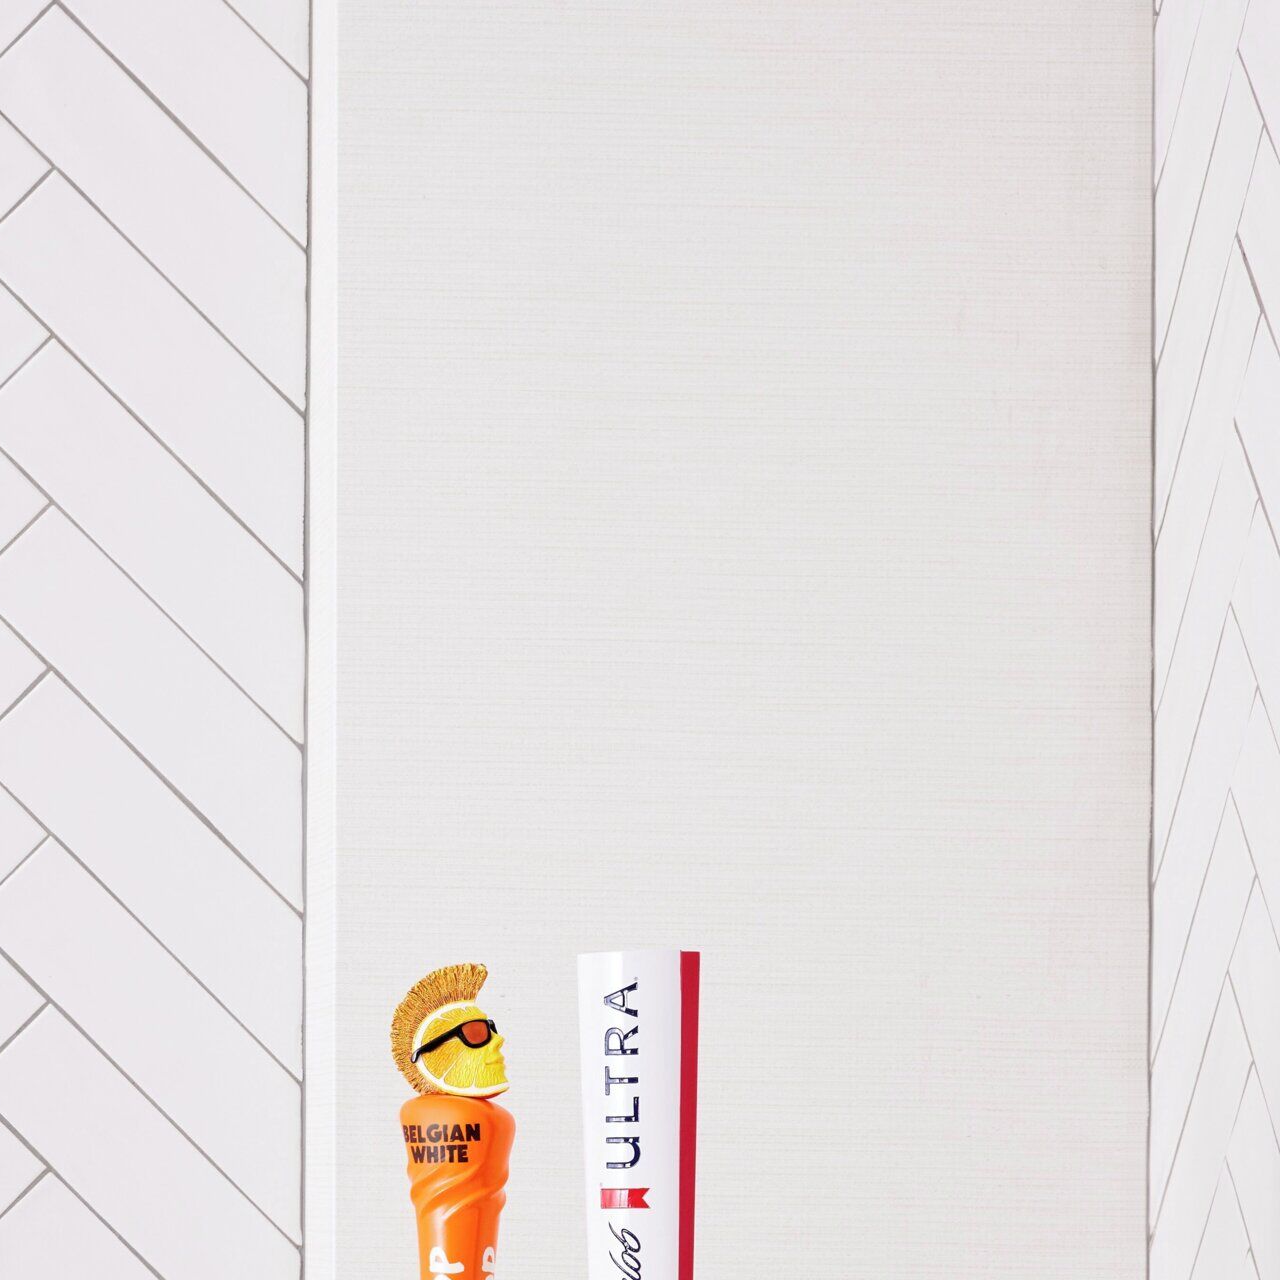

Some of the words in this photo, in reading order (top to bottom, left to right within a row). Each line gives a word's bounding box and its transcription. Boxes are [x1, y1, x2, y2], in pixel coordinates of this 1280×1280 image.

[603, 982, 641, 1169] ULTRA
[402, 1123, 481, 1143] BELGIAN
[410, 1144, 469, 1164] WHITE
